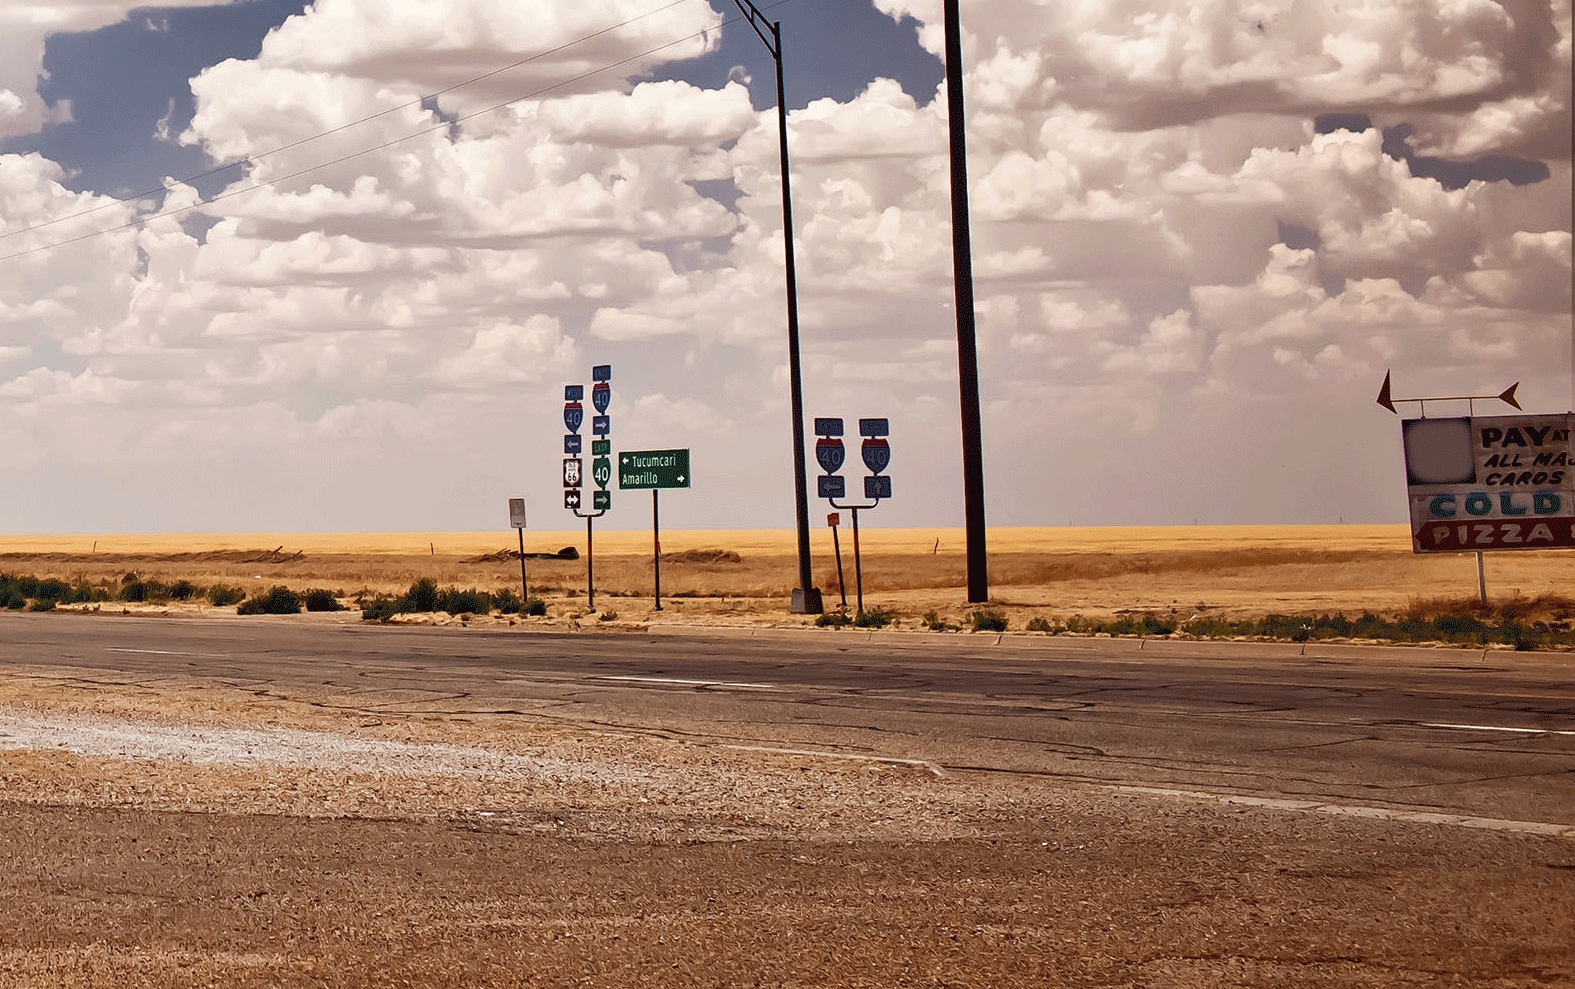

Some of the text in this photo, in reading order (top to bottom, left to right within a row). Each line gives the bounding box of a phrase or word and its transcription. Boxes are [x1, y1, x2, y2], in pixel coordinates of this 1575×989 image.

[595, 392, 608, 406] 40
[566, 412, 581, 426] 40
[1481, 426, 1570, 448] PAY AT
[632, 453, 676, 467] Tucumcari
[821, 450, 841, 465] 40
[866, 450, 886, 465] 40
[1484, 453, 1522, 467] ALL
[568, 472, 577, 481] 66
[595, 467, 608, 481] 40
[622, 471, 658, 485] Amarillo
[1485, 471, 1566, 486] CARDS
[1429, 489, 1562, 518] COLD
[1433, 523, 1554, 545] PIZZA
